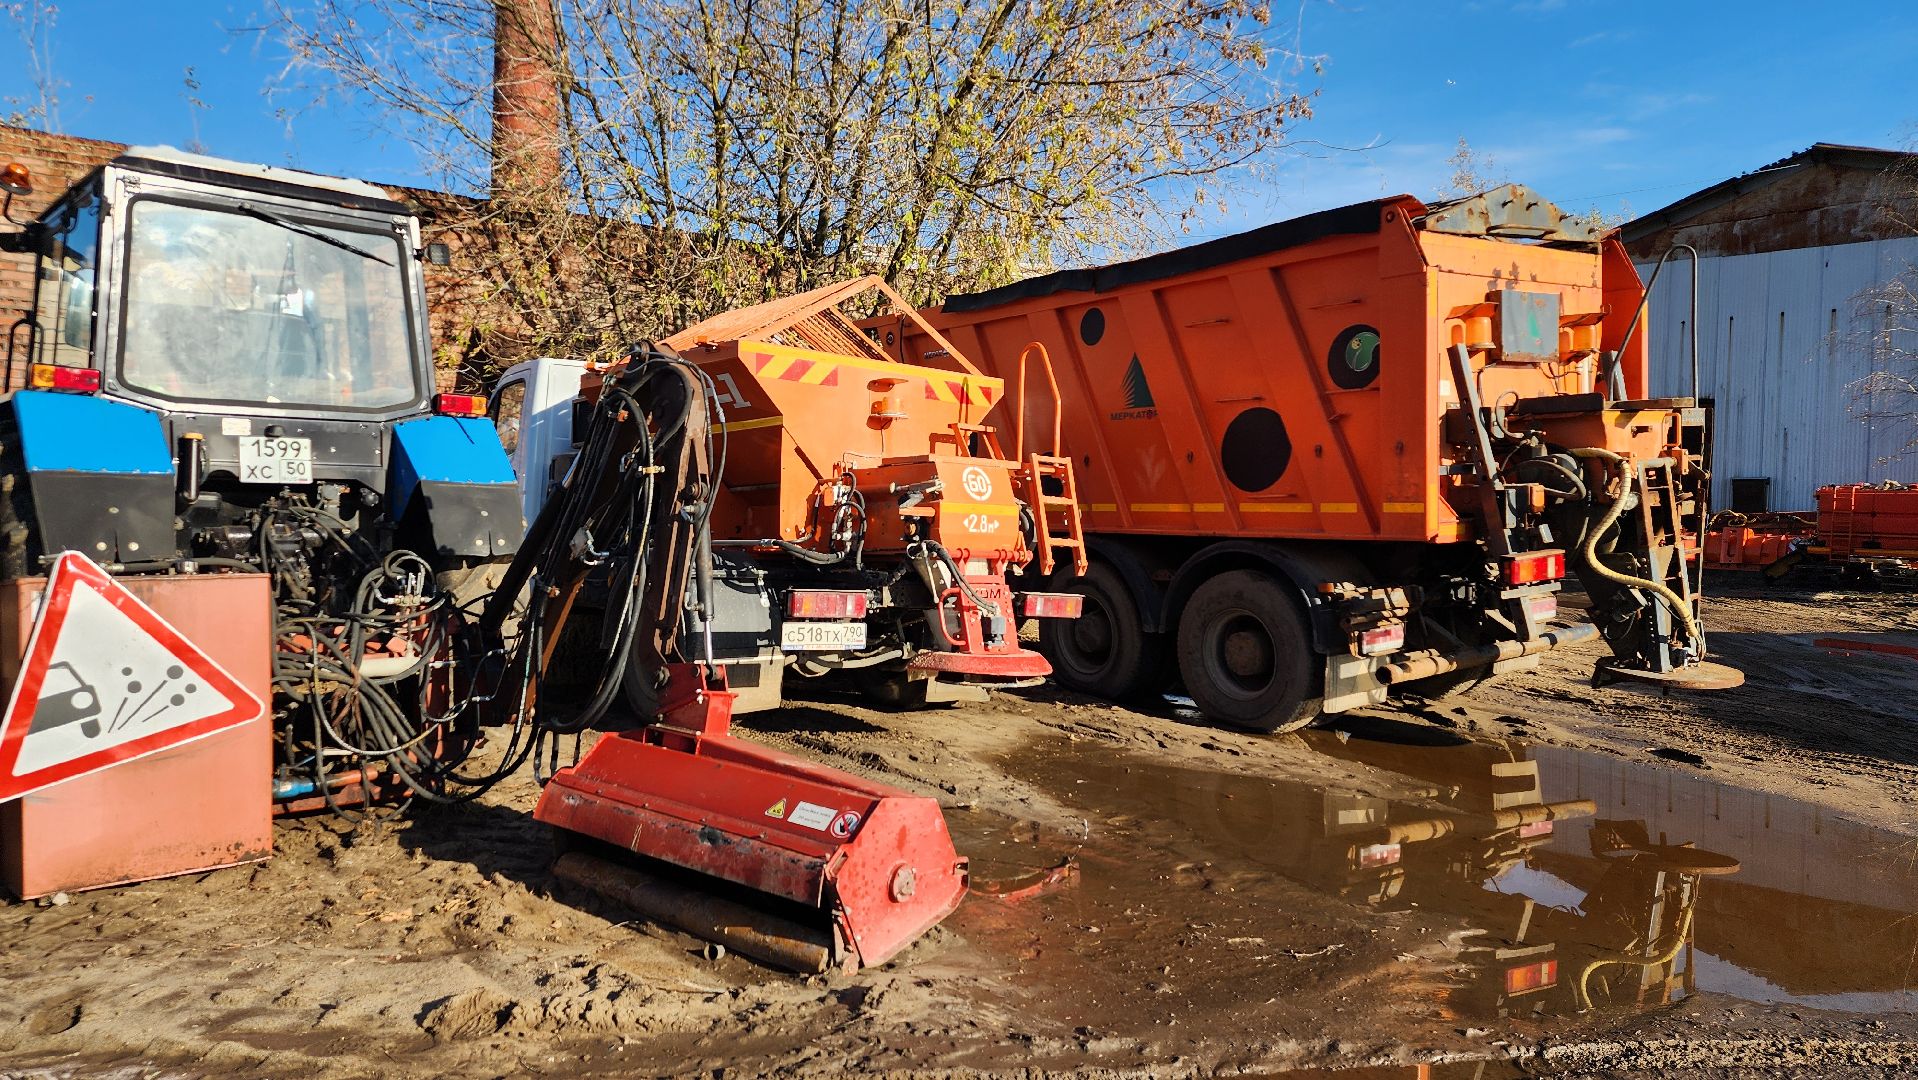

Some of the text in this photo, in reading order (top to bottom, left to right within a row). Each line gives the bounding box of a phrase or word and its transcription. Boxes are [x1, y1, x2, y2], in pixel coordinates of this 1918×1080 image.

[251, 439, 301, 457] 1599
[247, 462, 305, 478] ХС 50
[967, 474, 987, 492] 60
[787, 626, 862, 642] С518ТХ 790
